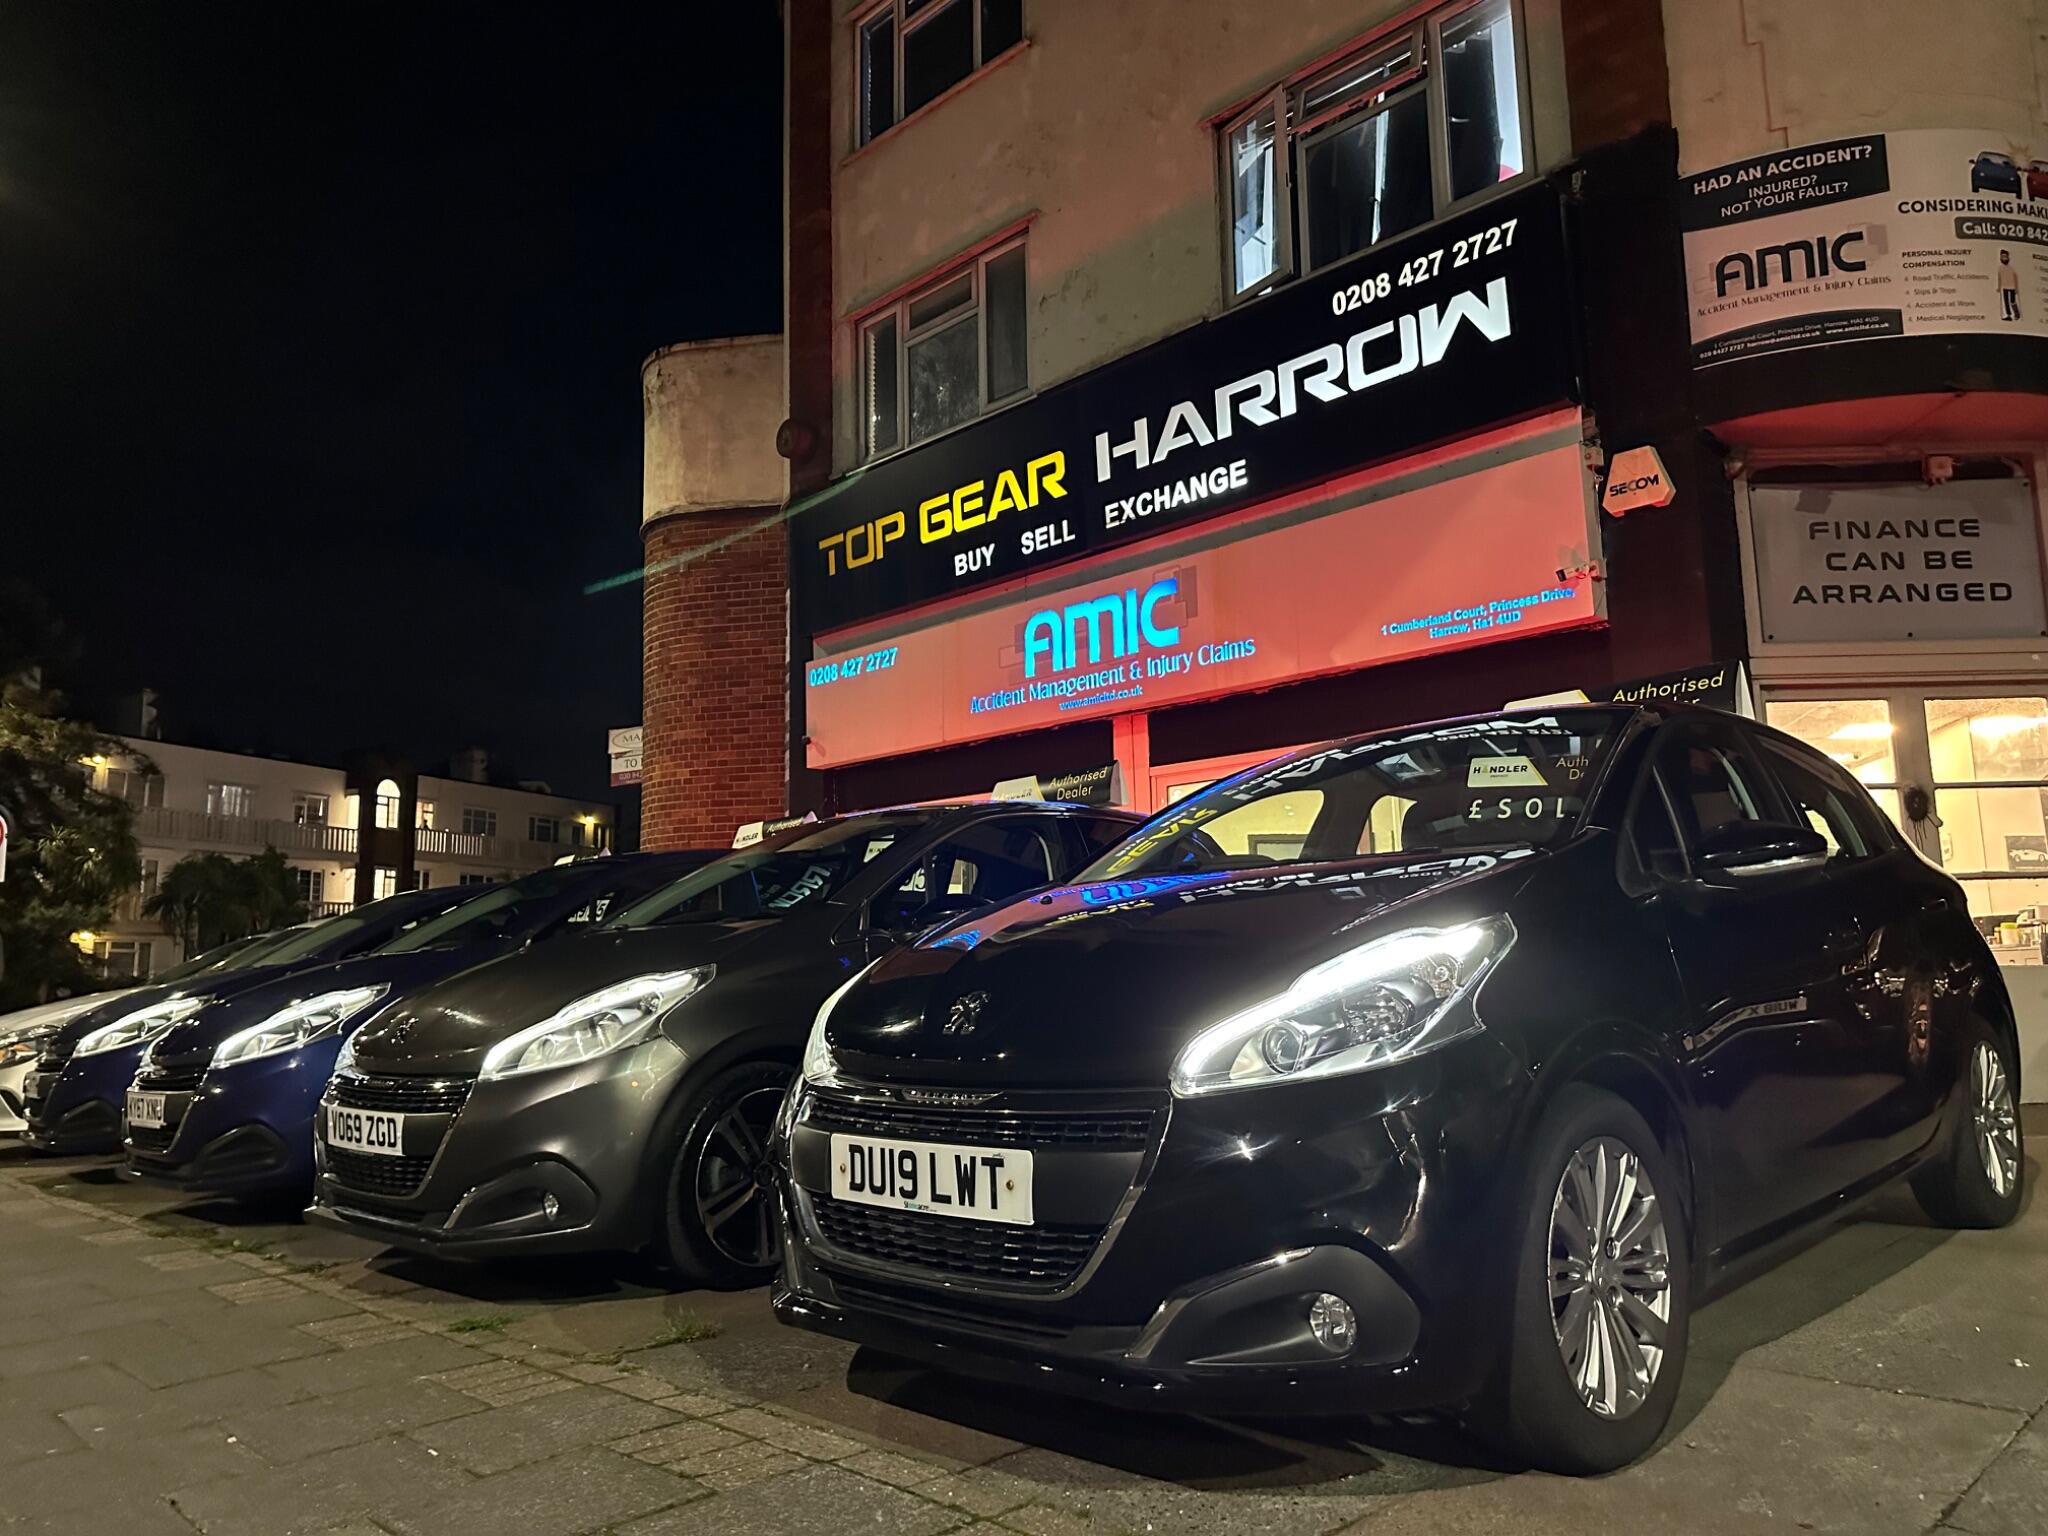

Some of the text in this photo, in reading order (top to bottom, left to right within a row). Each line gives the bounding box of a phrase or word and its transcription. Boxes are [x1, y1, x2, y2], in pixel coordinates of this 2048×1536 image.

[1694, 145, 1872, 195] HAD AN ACCIDENT?
[1720, 182, 1849, 217] NOT YOUR FAULT?
[1749, 175, 1817, 198] INJURED?
[1898, 199, 2014, 214] CONSIDERING
[1963, 222, 1996, 235] Call:
[1999, 224, 2024, 237] 020
[1333, 218, 1518, 316] 0208 427 2727
[1715, 231, 1866, 297] AMIC
[1902, 249, 1943, 258] PERSONAL
[1902, 260, 1966, 269] COMPENSATION
[1697, 275, 1892, 316] Accident Management & Injury Claims
[818, 276, 1511, 576] TOP GEAR HARROW
[1609, 474, 1660, 497] SECOM
[954, 459, 1249, 576] BUY SELL EXCHANGE
[1808, 518, 1982, 540] FINANCE
[1825, 550, 1974, 571] CAN BE
[1792, 582, 2013, 604] ARRANGED
[1389, 612, 1452, 634] Cumberland
[1454, 605, 1487, 621] Court,
[1489, 594, 1539, 613] Princess
[1540, 587, 1575, 602] Drive,
[1429, 623, 1470, 639] Harrow,
[1496, 610, 1521, 625] 4UD
[1024, 577, 1180, 678] AMIC
[809, 647, 898, 687] 0208 427 2727
[970, 639, 1256, 714] Accident Management & Injury Claims
[1612, 670, 1724, 702] Authorised
[1048, 766, 1108, 789] Authorised
[1056, 785, 1093, 801] Dealer
[736, 832, 759, 844] HNDLER
[331, 1111, 397, 1148] VO69 ZGD
[848, 1143, 1004, 1210] DU19 LWT
